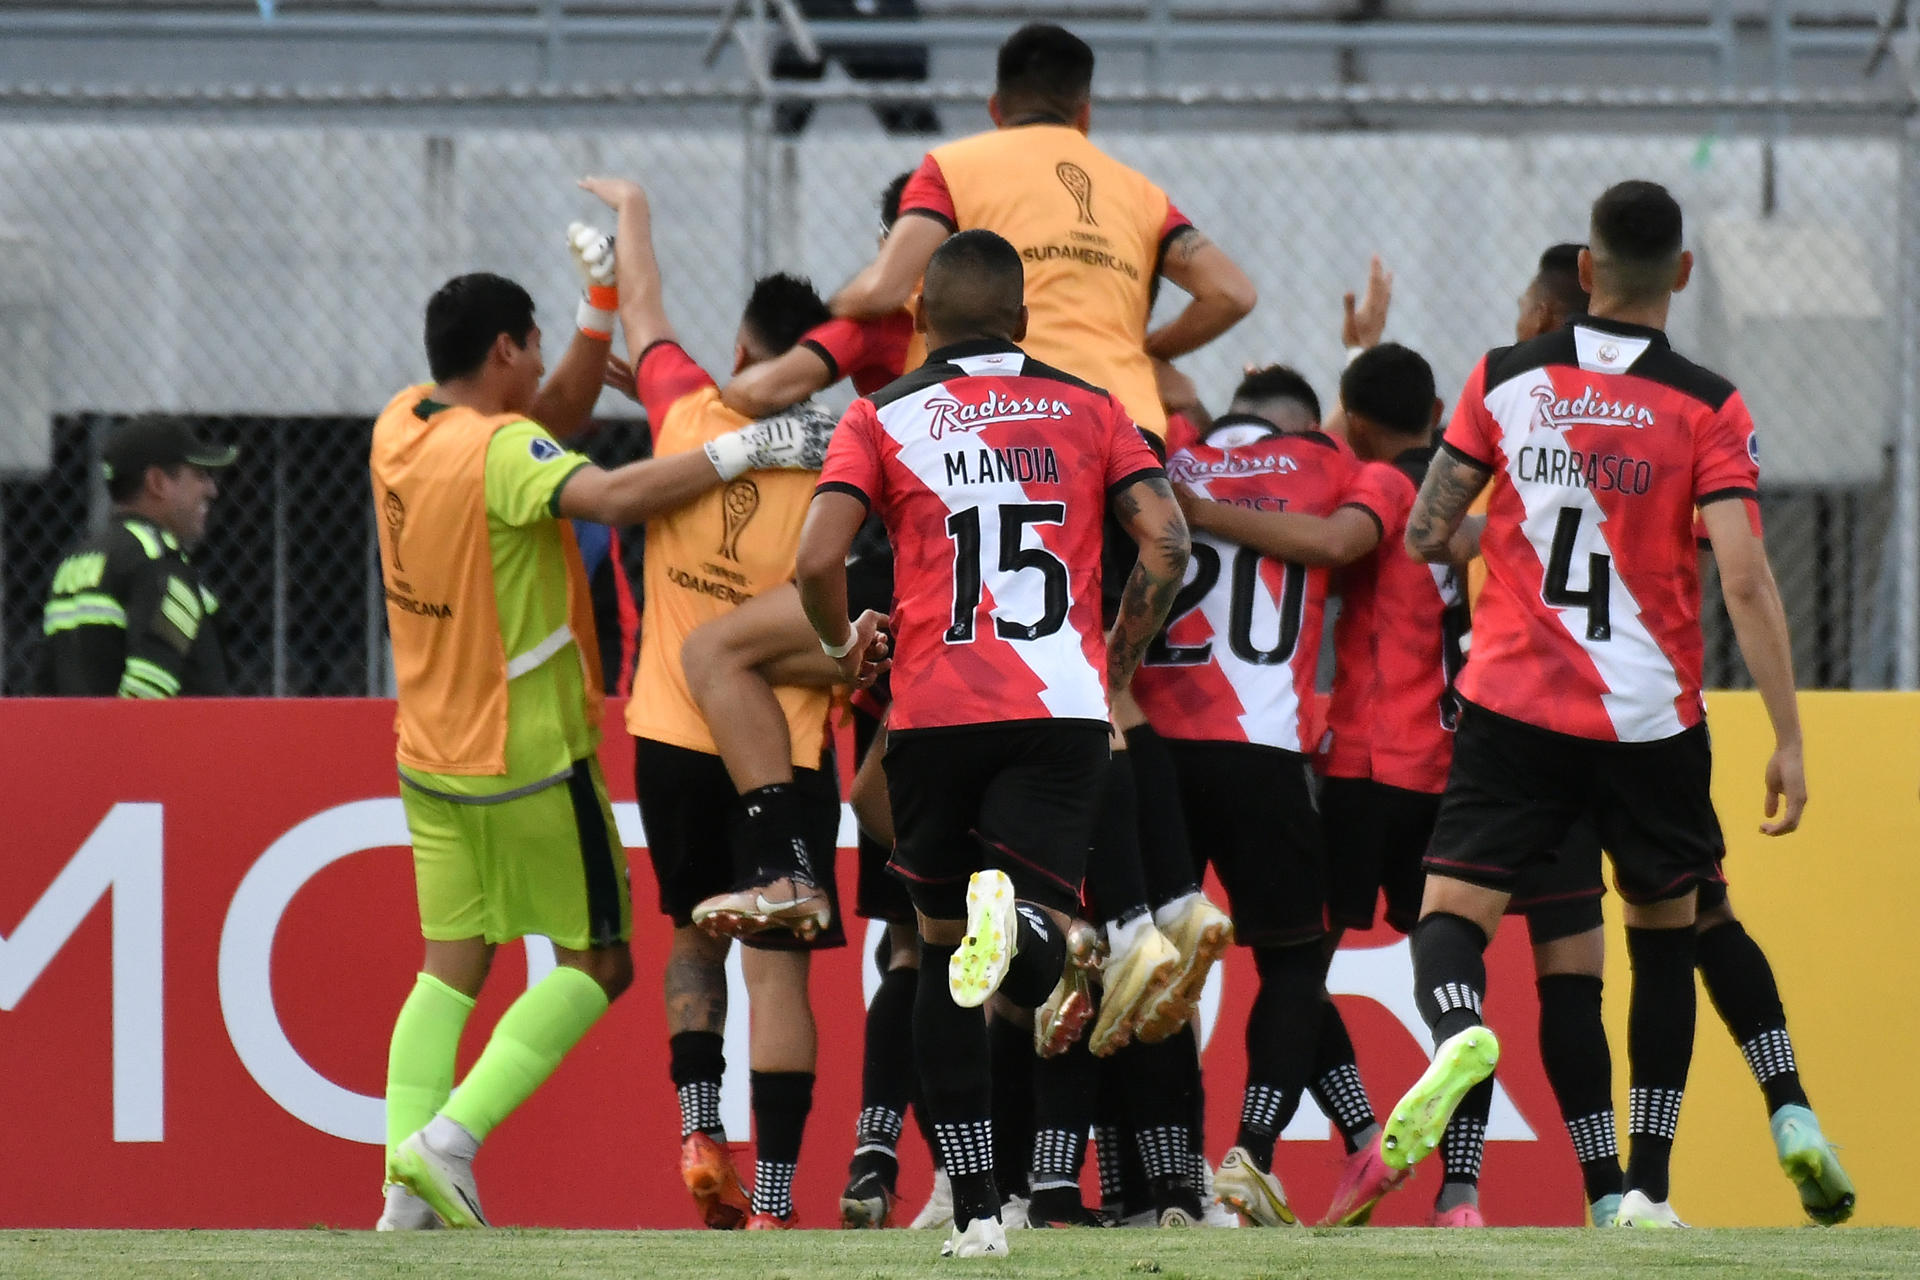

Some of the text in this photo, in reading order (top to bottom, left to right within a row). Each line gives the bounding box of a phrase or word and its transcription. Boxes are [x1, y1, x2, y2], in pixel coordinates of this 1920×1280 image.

[1022, 244, 1139, 281] SUDAMERICANA
[924, 389, 1072, 440] Radisson
[1529, 385, 1654, 432] Radisson
[943, 447, 1060, 486] M.ANDIA
[1168, 449, 1299, 484] Radisson
[1518, 445, 1651, 497] CARRASCO
[943, 501, 1075, 645] 15
[1540, 505, 1612, 642] 4
[1142, 541, 1308, 668] 20
